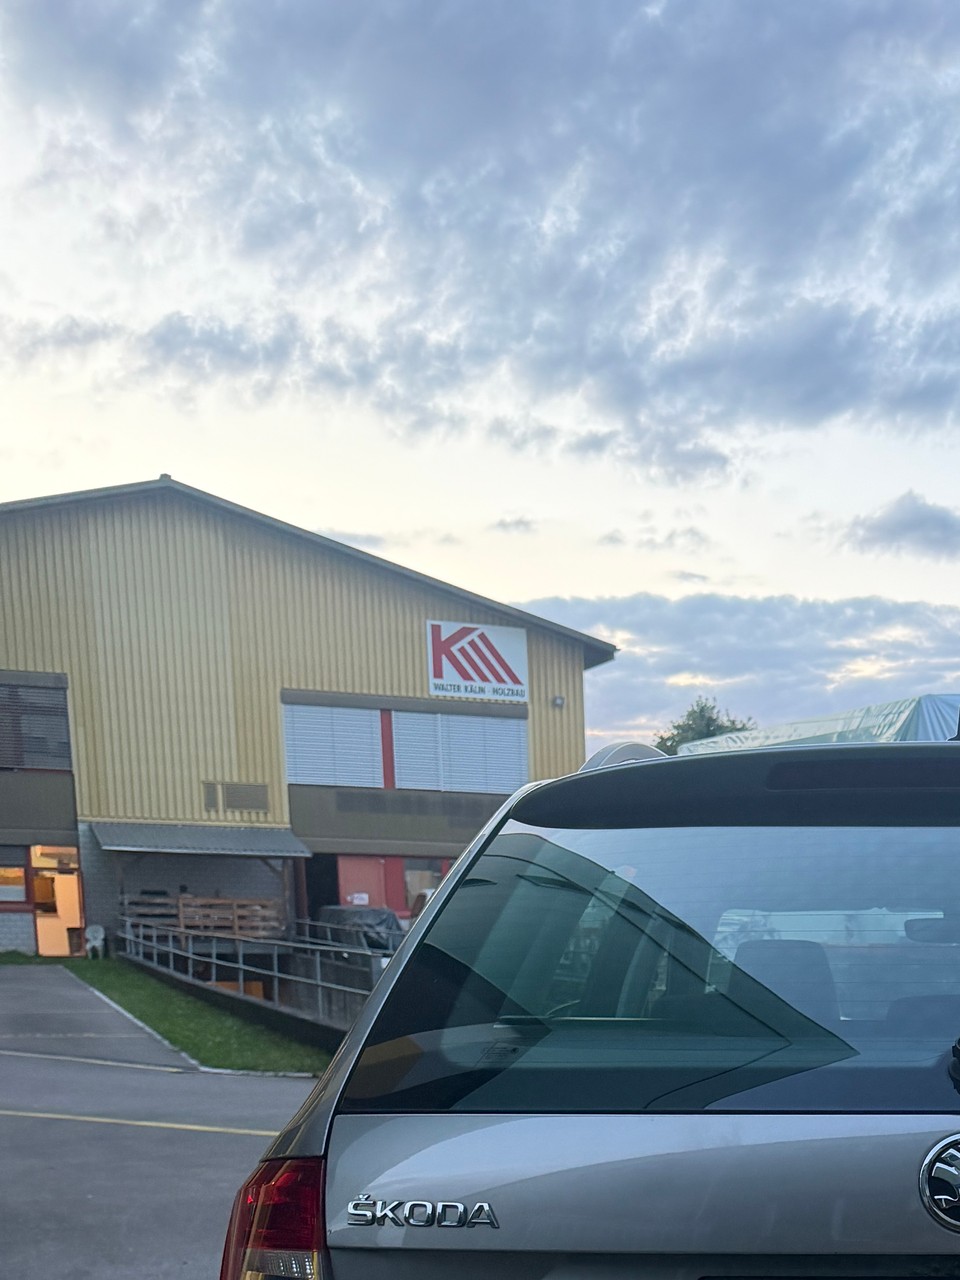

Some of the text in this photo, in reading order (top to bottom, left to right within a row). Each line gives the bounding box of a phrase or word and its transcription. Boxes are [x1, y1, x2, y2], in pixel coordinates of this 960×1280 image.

[433, 682, 462, 693] WALTER
[464, 683, 486, 695] KÄLIN
[492, 687, 526, 698] HOLZBAU
[347, 1194, 500, 1229] ŠKODA
